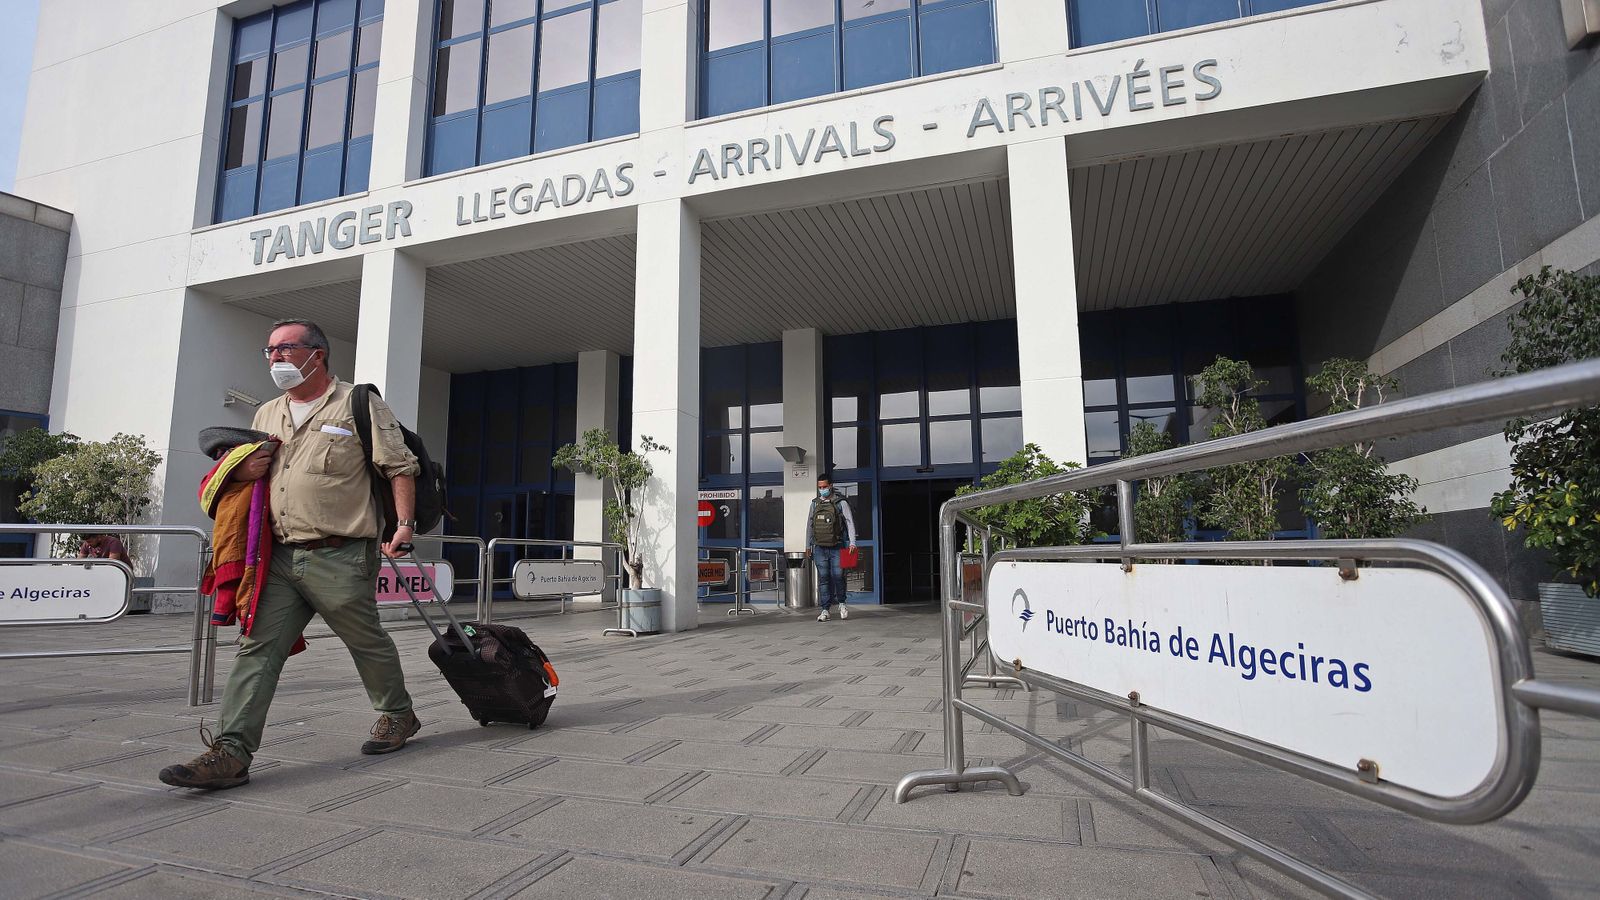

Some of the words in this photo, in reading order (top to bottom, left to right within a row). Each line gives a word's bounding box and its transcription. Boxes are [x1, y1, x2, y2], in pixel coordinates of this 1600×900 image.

[456, 162, 635, 227] LLEGADAS
[688, 114, 896, 184] ARRIVALS
[966, 58, 1222, 138] ARRIVÉES
[249, 199, 414, 266] TANGER
[10, 587, 91, 602] Algeciras
[395, 576, 432, 593] MED
[1046, 609, 1099, 641] Puerto
[1104, 617, 1161, 654] Bahía
[1169, 625, 1199, 661] de
[1208, 632, 1373, 694] Algeciras
